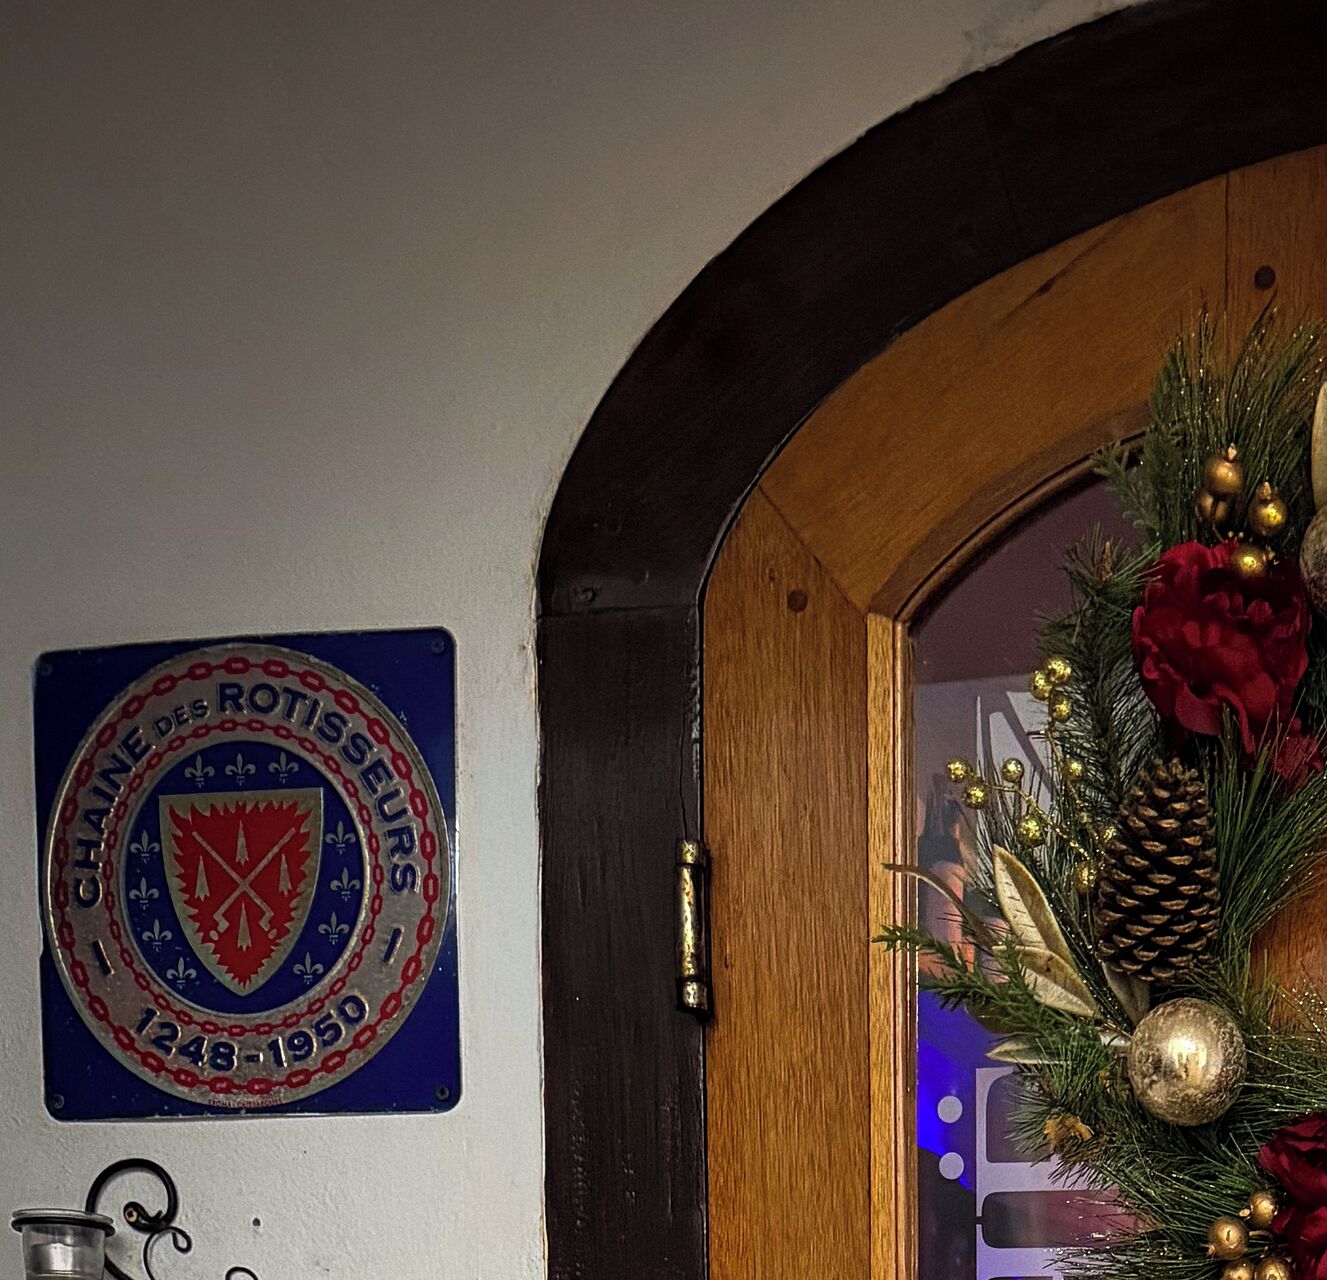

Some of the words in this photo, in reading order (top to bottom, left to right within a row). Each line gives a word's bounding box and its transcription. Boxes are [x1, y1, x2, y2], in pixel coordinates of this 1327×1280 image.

[74, 725, 155, 909] CHAINE
[154, 698, 209, 739] DES
[216, 682, 420, 895] ROTISSEURS
